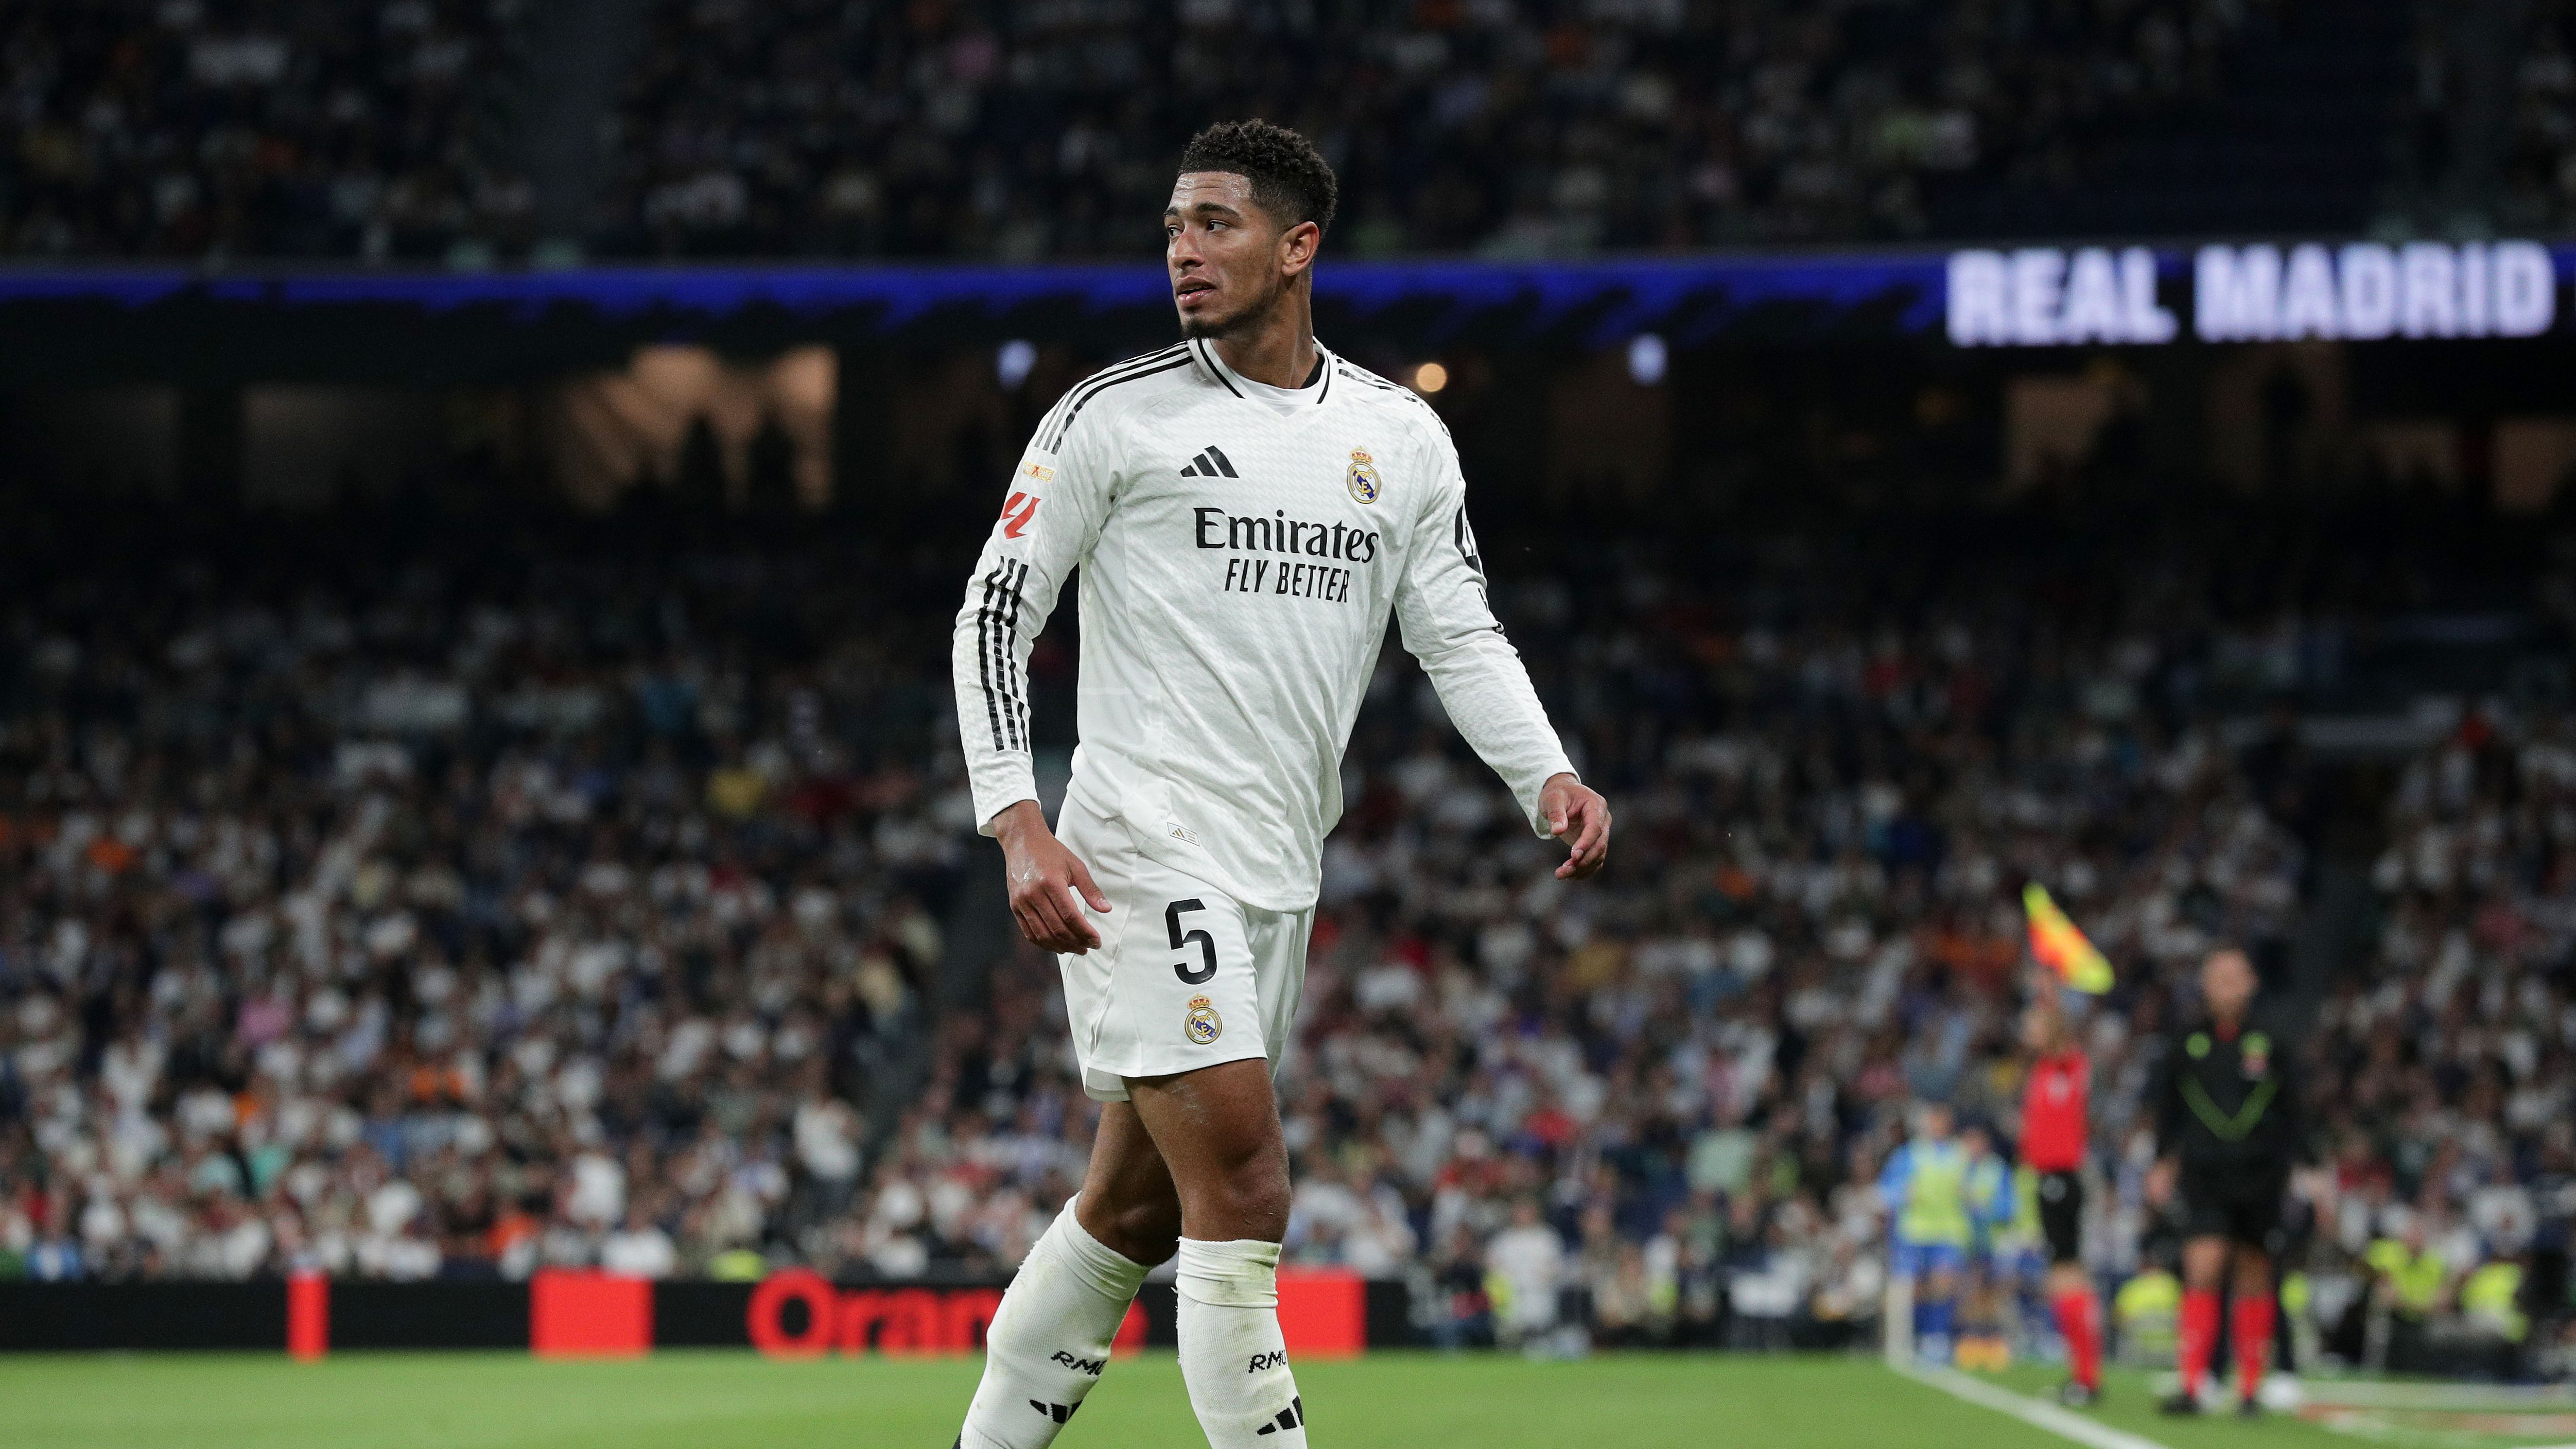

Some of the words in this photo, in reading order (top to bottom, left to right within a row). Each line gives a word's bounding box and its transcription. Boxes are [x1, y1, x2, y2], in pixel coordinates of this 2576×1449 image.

[1947, 247, 2178, 346] REAL
[2194, 241, 2556, 342] MADRID
[1193, 507, 1379, 564] Emirates
[1225, 558, 1269, 592] FLY
[1275, 562, 1350, 603] BETTER
[1165, 898, 1217, 985] 5
[746, 1266, 1149, 1360] Oran
